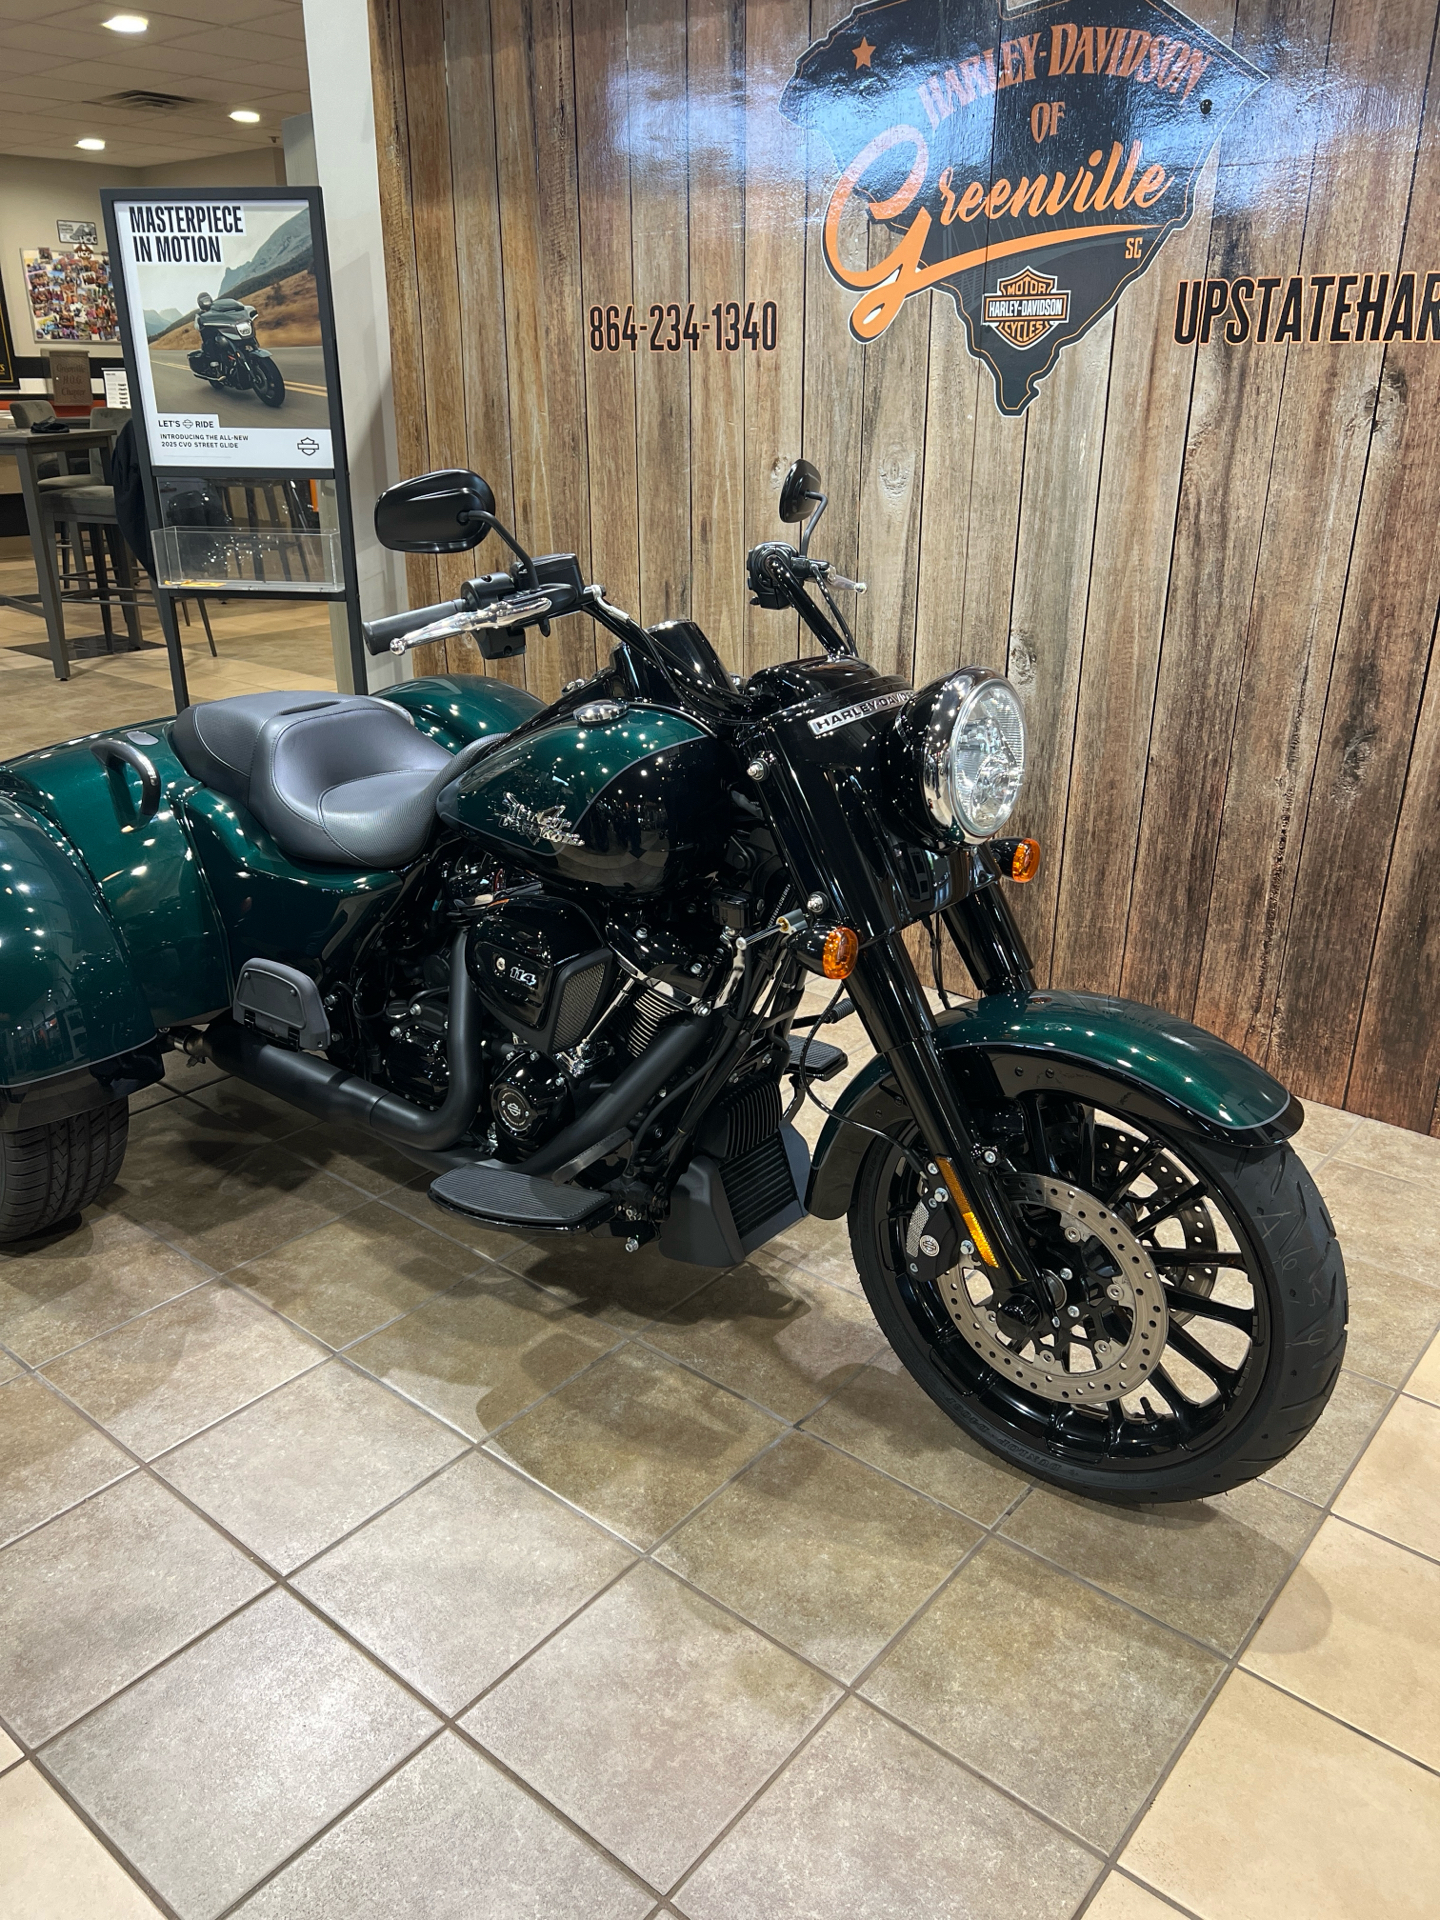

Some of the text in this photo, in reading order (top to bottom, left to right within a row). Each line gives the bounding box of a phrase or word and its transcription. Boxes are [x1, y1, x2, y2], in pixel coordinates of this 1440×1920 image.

[917, 23, 1213, 131] HARLEY-DAVIDSON
[1031, 101, 1066, 144] OF
[129, 205, 244, 233] MASTERPIECE
[823, 124, 1174, 342] Greenville
[132, 235, 222, 262] IN MOTION
[1125, 237, 1143, 260] SC
[1006, 276, 1046, 295] MOTOR
[988, 299, 1063, 317] HARLEY-DAVIDSON
[589, 300, 778, 353] 864-234-1340
[1004, 321, 1044, 342] CYCLES
[158, 420, 214, 429] LET'S RIDE
[510, 966, 537, 986] 114
[998, 1438, 1063, 1473] DUNLOP
